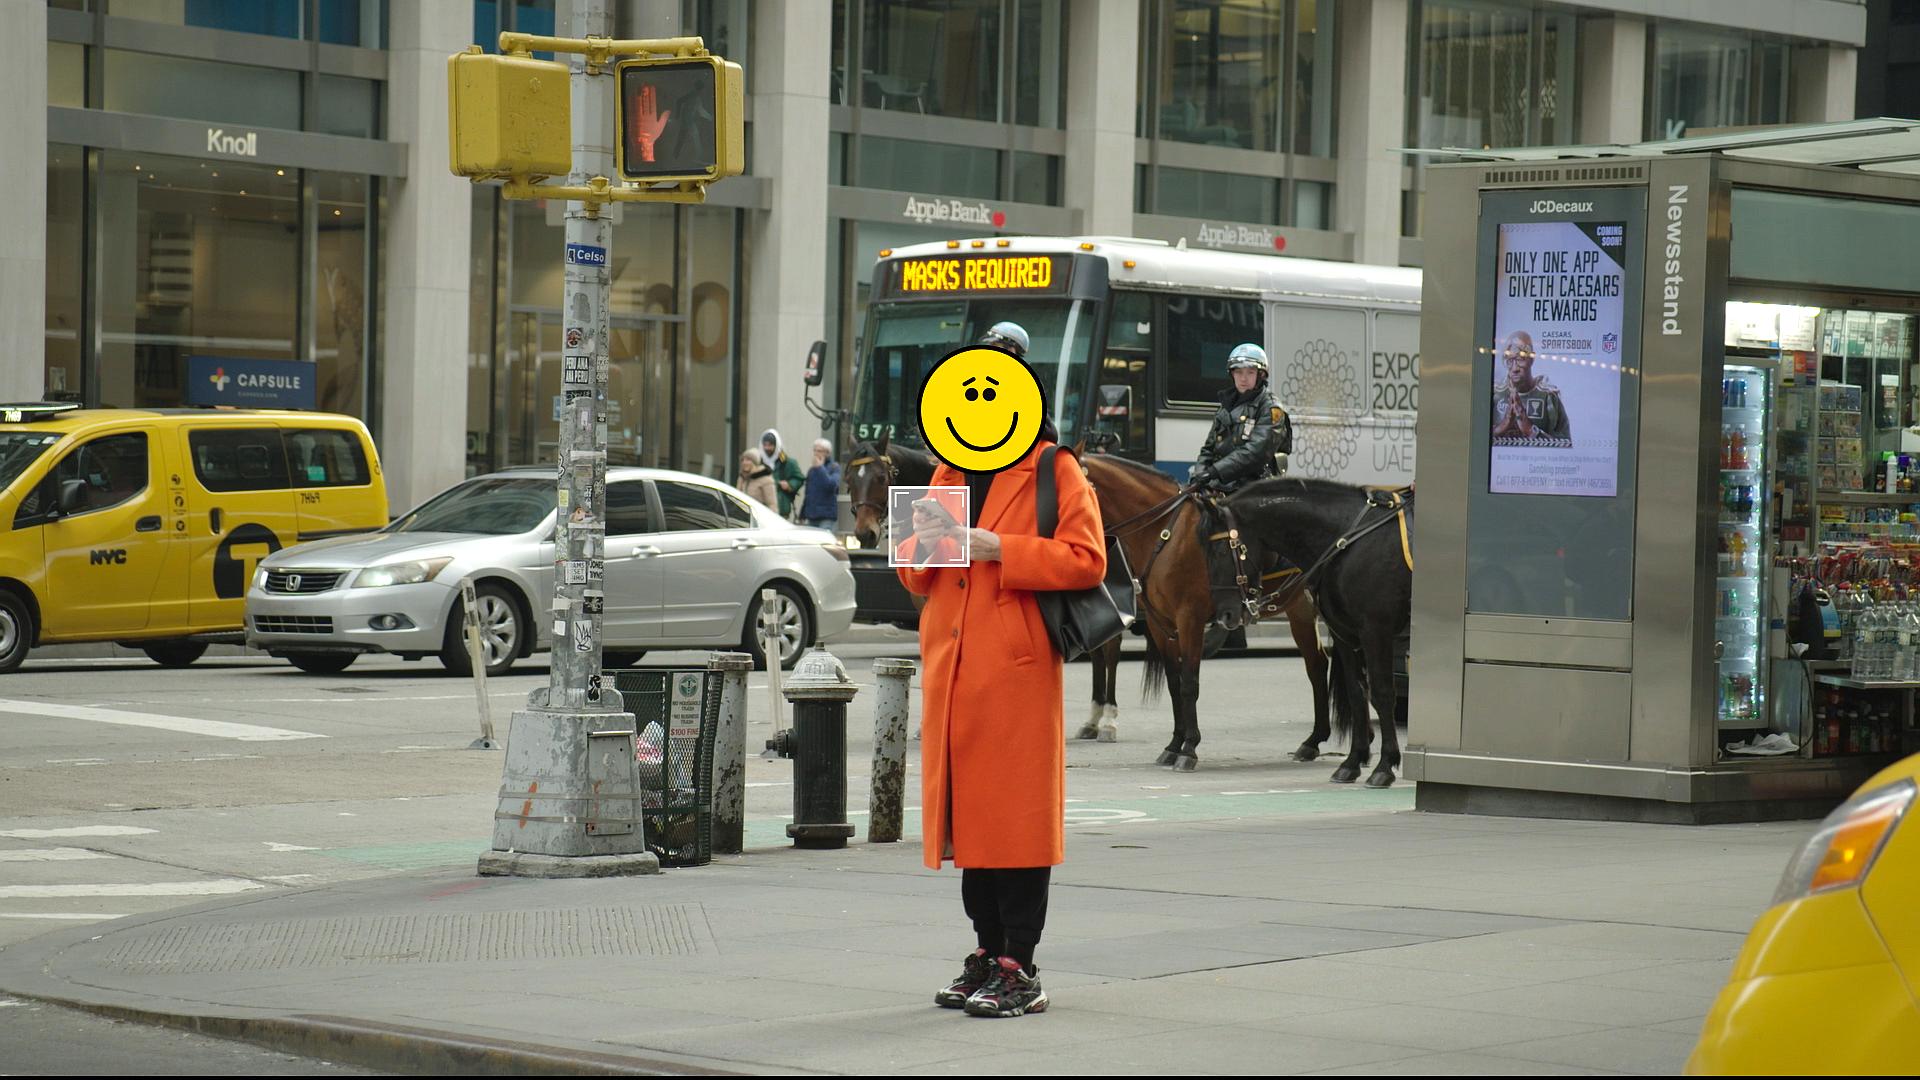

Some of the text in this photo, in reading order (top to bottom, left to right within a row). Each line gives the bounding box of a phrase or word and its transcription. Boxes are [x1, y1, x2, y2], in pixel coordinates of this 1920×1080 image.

[207, 128, 257, 156] Knoll
[903, 196, 991, 224] Apple Bank
[1529, 200, 1594, 214] JCDecaux
[1197, 222, 1273, 248] Apple Bank
[1597, 225, 1623, 236] COMING
[1601, 236, 1623, 246] SOON!
[577, 249, 605, 263] Celso
[1504, 250, 1600, 274] ONLY ONE APP
[1662, 185, 1688, 335] Newsstand
[903, 256, 1051, 291] MASKS REQUIRED
[1508, 274, 1620, 297] GIVETH CAESARS
[1533, 299, 1598, 322] REWARDS
[1541, 339, 1593, 350] SPORTSBOOK
[237, 373, 301, 389] CAPSULE
[1372, 443, 1413, 473] UAE
[90, 549, 127, 565] NYC
[671, 727, 700, 736] $100 FINE
